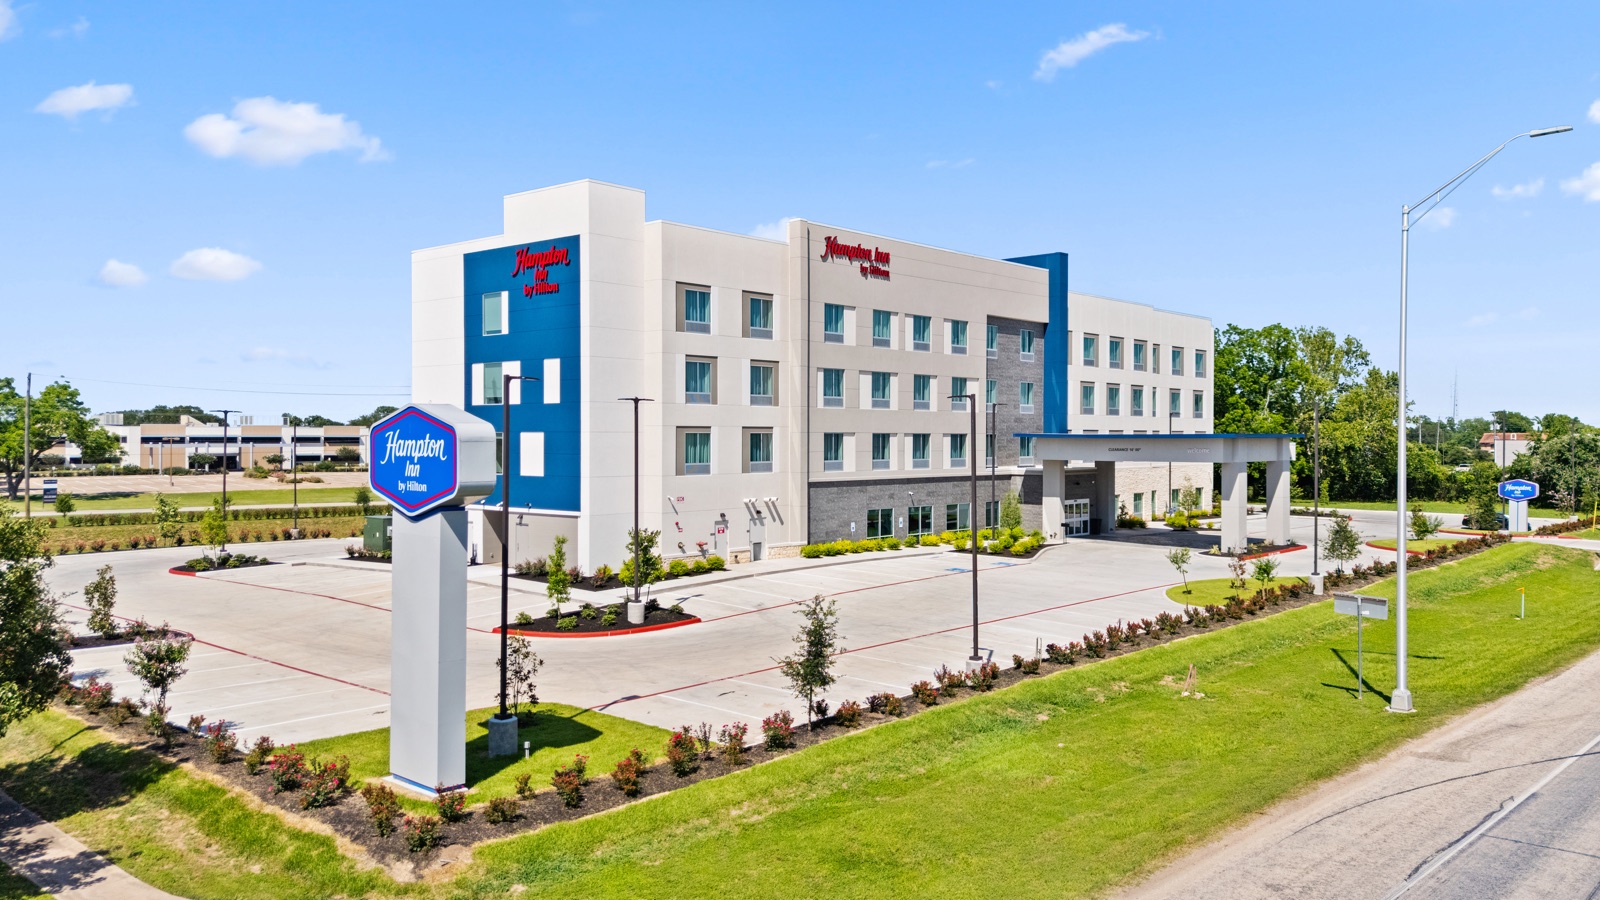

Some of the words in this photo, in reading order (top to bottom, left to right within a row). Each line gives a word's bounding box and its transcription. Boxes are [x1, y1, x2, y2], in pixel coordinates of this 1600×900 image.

[820, 236, 873, 263] Hampton
[874, 247, 890, 264] Inn
[511, 246, 570, 276] Hampton
[534, 268, 548, 280] Inn
[869, 265, 890, 277] Hilton
[524, 284, 533, 297] by
[534, 282, 559, 294] Hilton
[380, 429, 447, 464] Hampton
[405, 461, 420, 477] Inn
[398, 480, 407, 493] by
[407, 481, 427, 492] Hilton
[1504, 484, 1532, 492] Hampton
